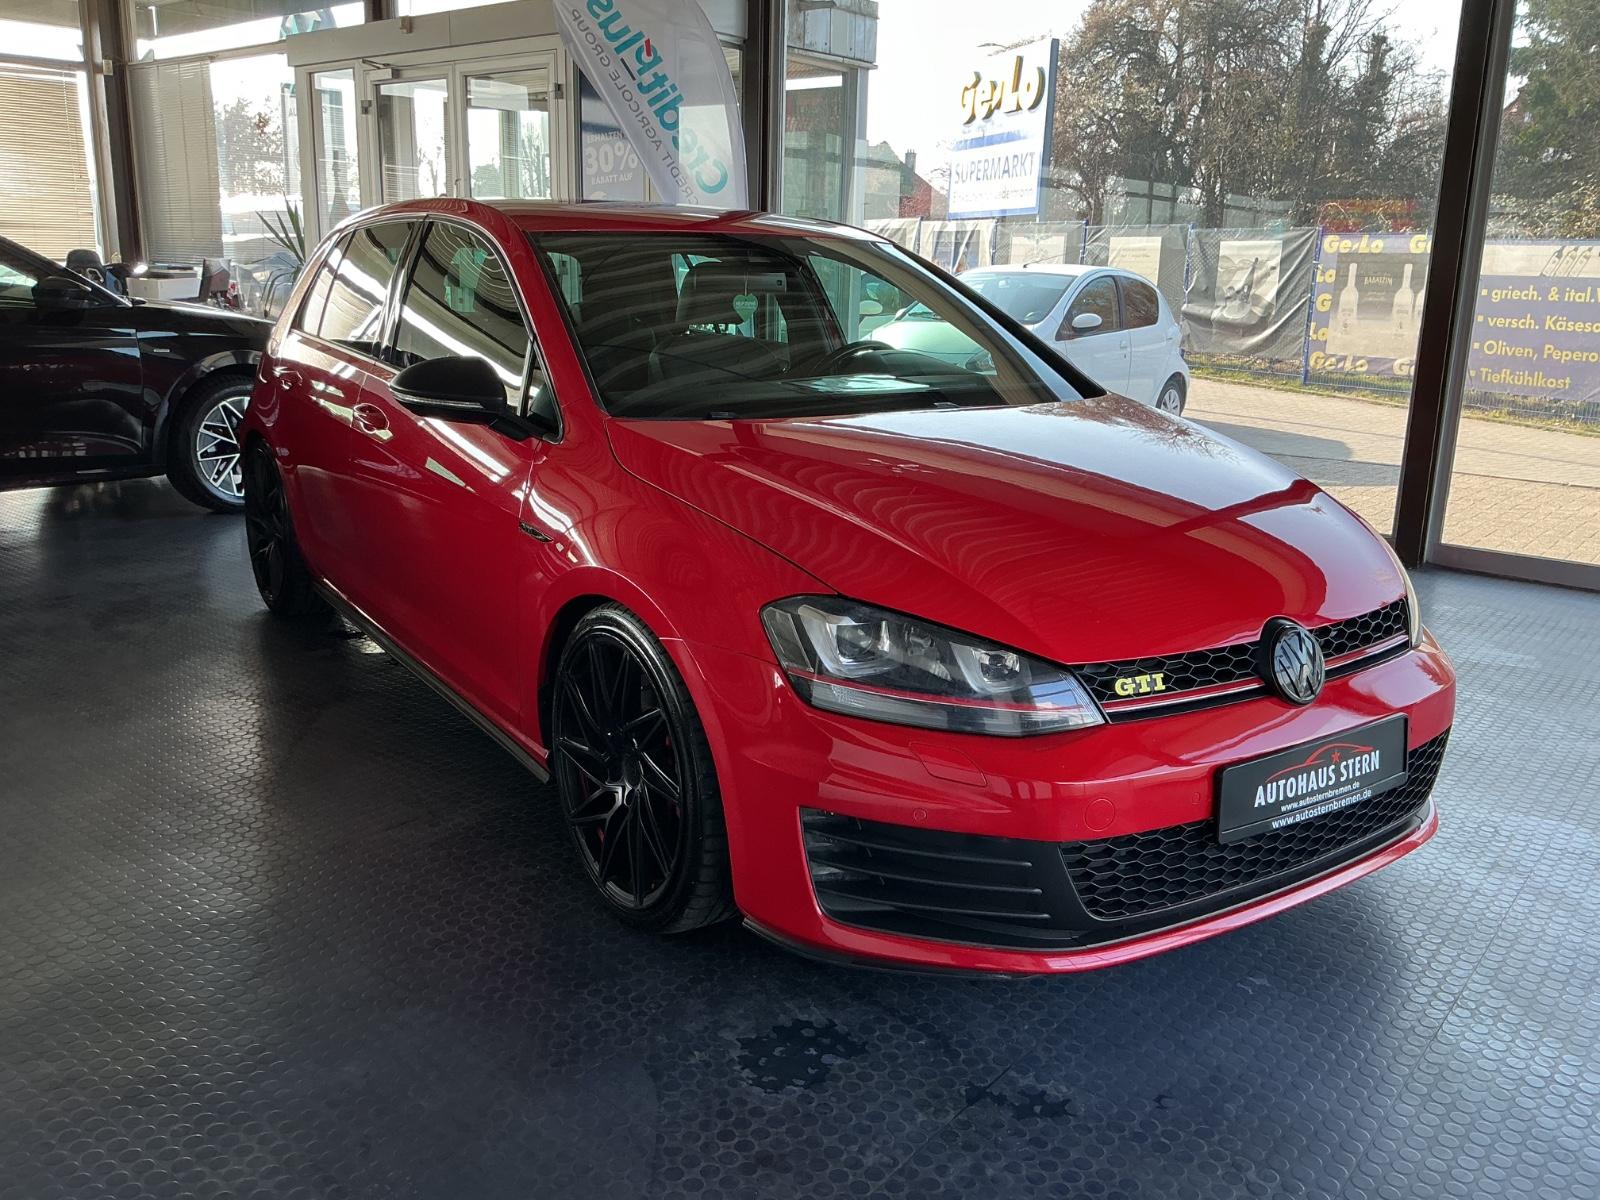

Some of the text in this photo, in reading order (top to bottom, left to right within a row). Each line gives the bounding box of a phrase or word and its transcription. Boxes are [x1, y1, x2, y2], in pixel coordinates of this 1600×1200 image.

[585, 141, 638, 176] 30%
[954, 151, 1036, 184] SUPERMARKT
[1491, 285, 1542, 302] griech.
[1548, 286, 1559, 301] &
[1487, 314, 1539, 329] versch.
[1483, 340, 1538, 361] Oliven,
[1480, 367, 1572, 390] Tiefkühlkost
[1114, 673, 1166, 697] GTI
[1254, 750, 1380, 808] AUTOHAUS STERN
[1271, 788, 1372, 829] www.autosternbremen.de
[1280, 780, 1360, 812] www.autosternbremen.de
